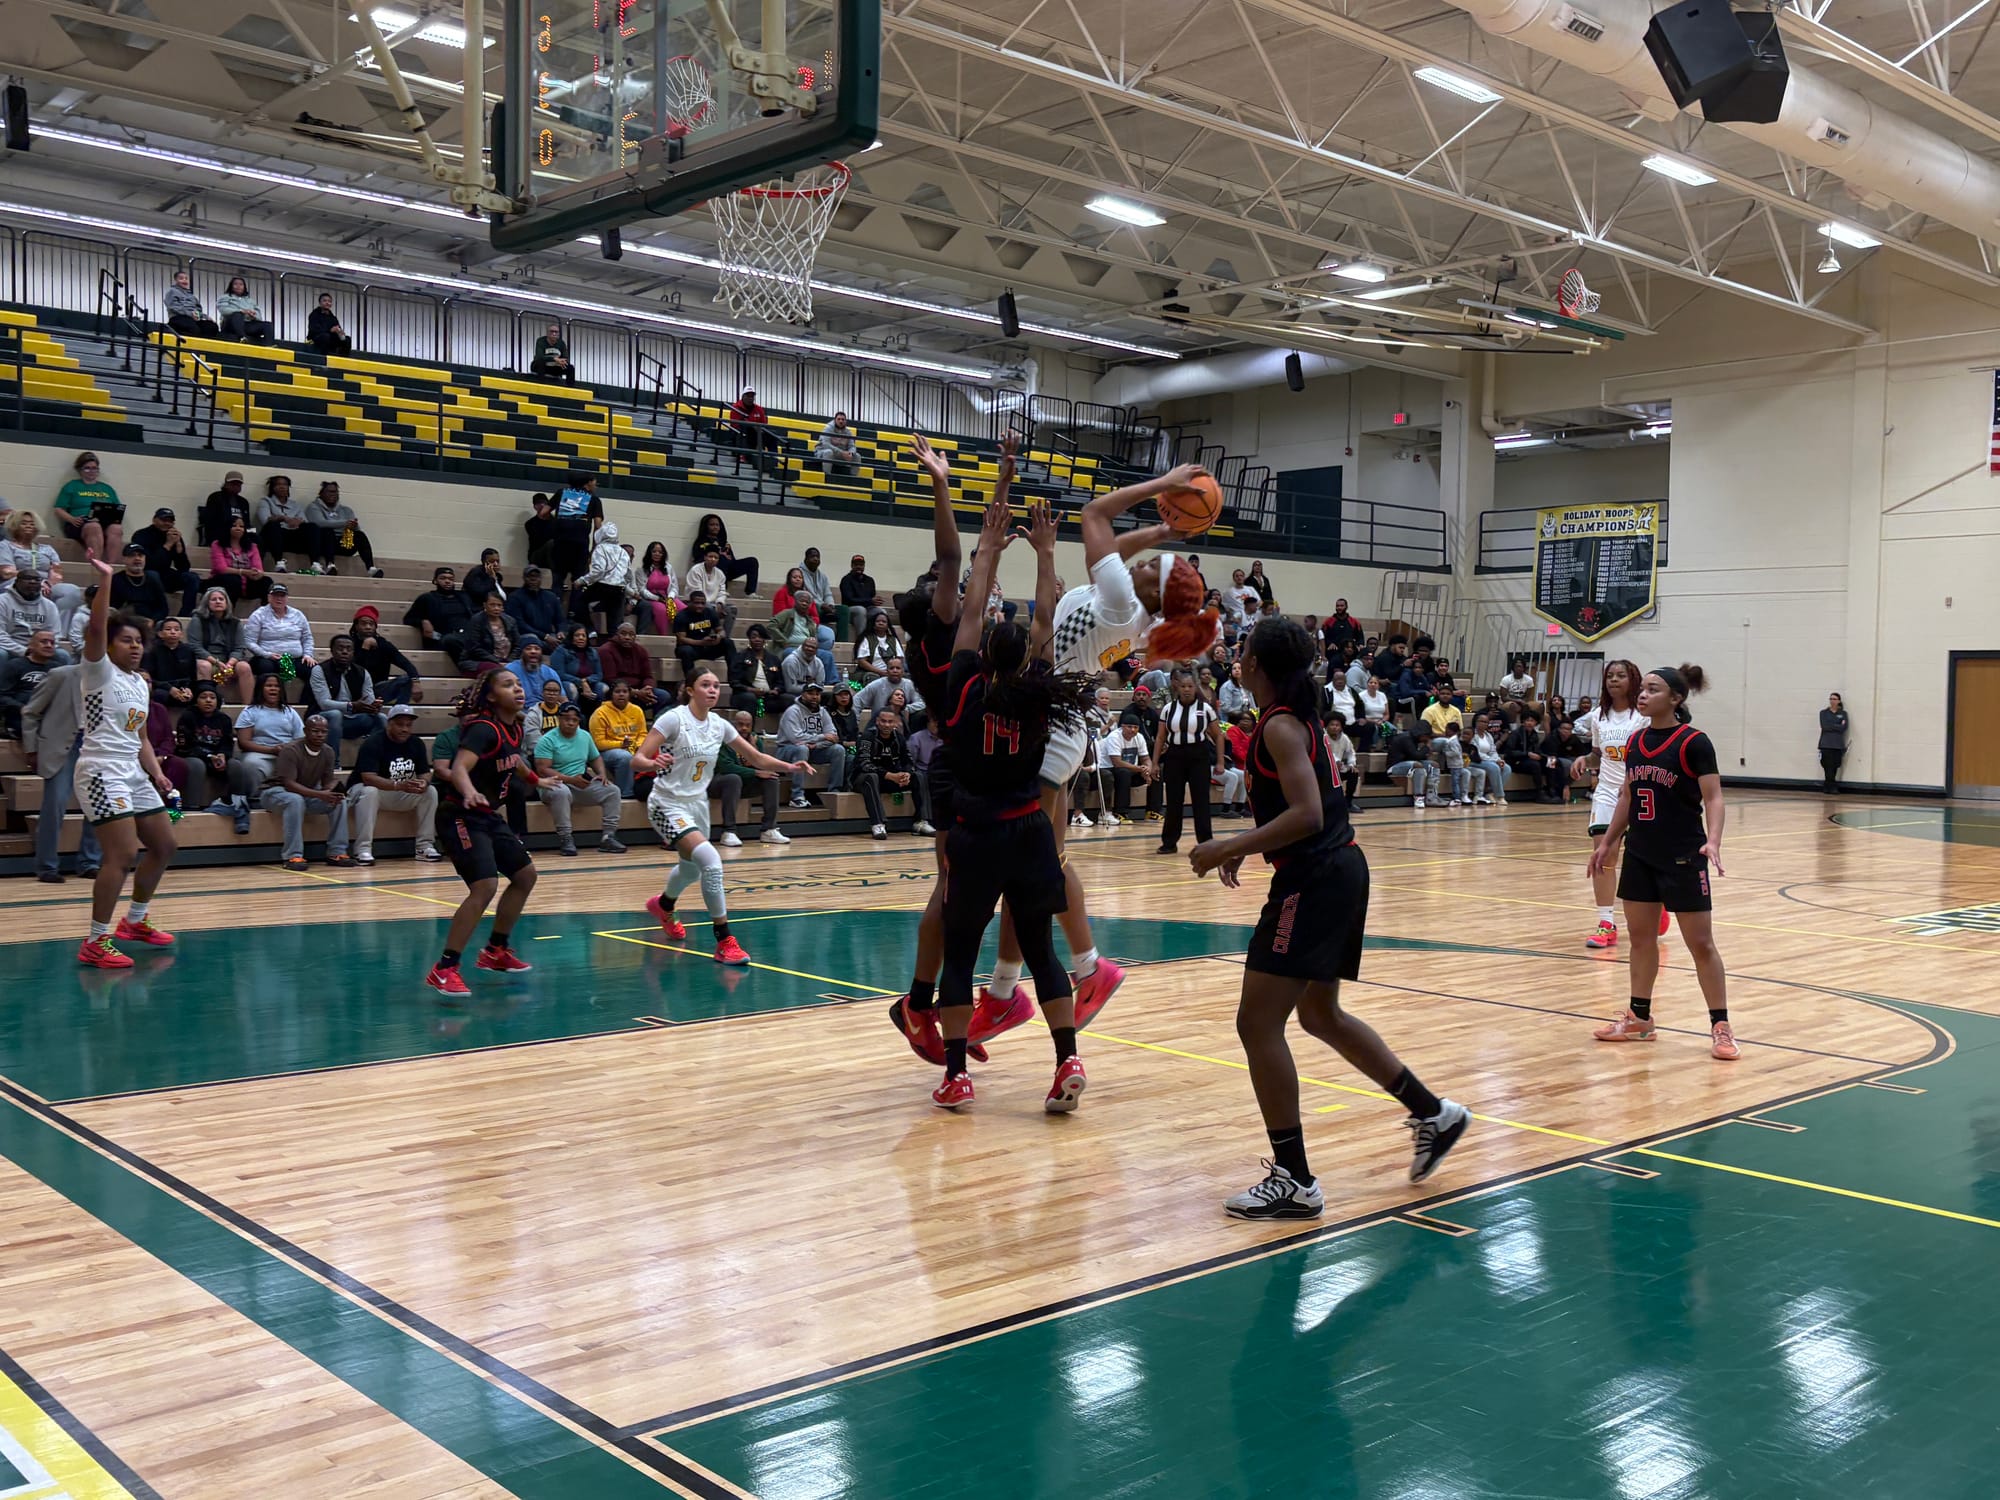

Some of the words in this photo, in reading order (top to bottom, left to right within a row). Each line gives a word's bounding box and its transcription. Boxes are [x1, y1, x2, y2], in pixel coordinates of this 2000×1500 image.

[1560, 519, 1635, 534] CHAMPIONS
[1564, 510, 1601, 521] HOLIDAY
[1605, 508, 1634, 518] HOOPS
[982, 712, 1021, 755] 14
[1629, 764, 1679, 789] AMPTON
[1637, 788, 1656, 821] 3
